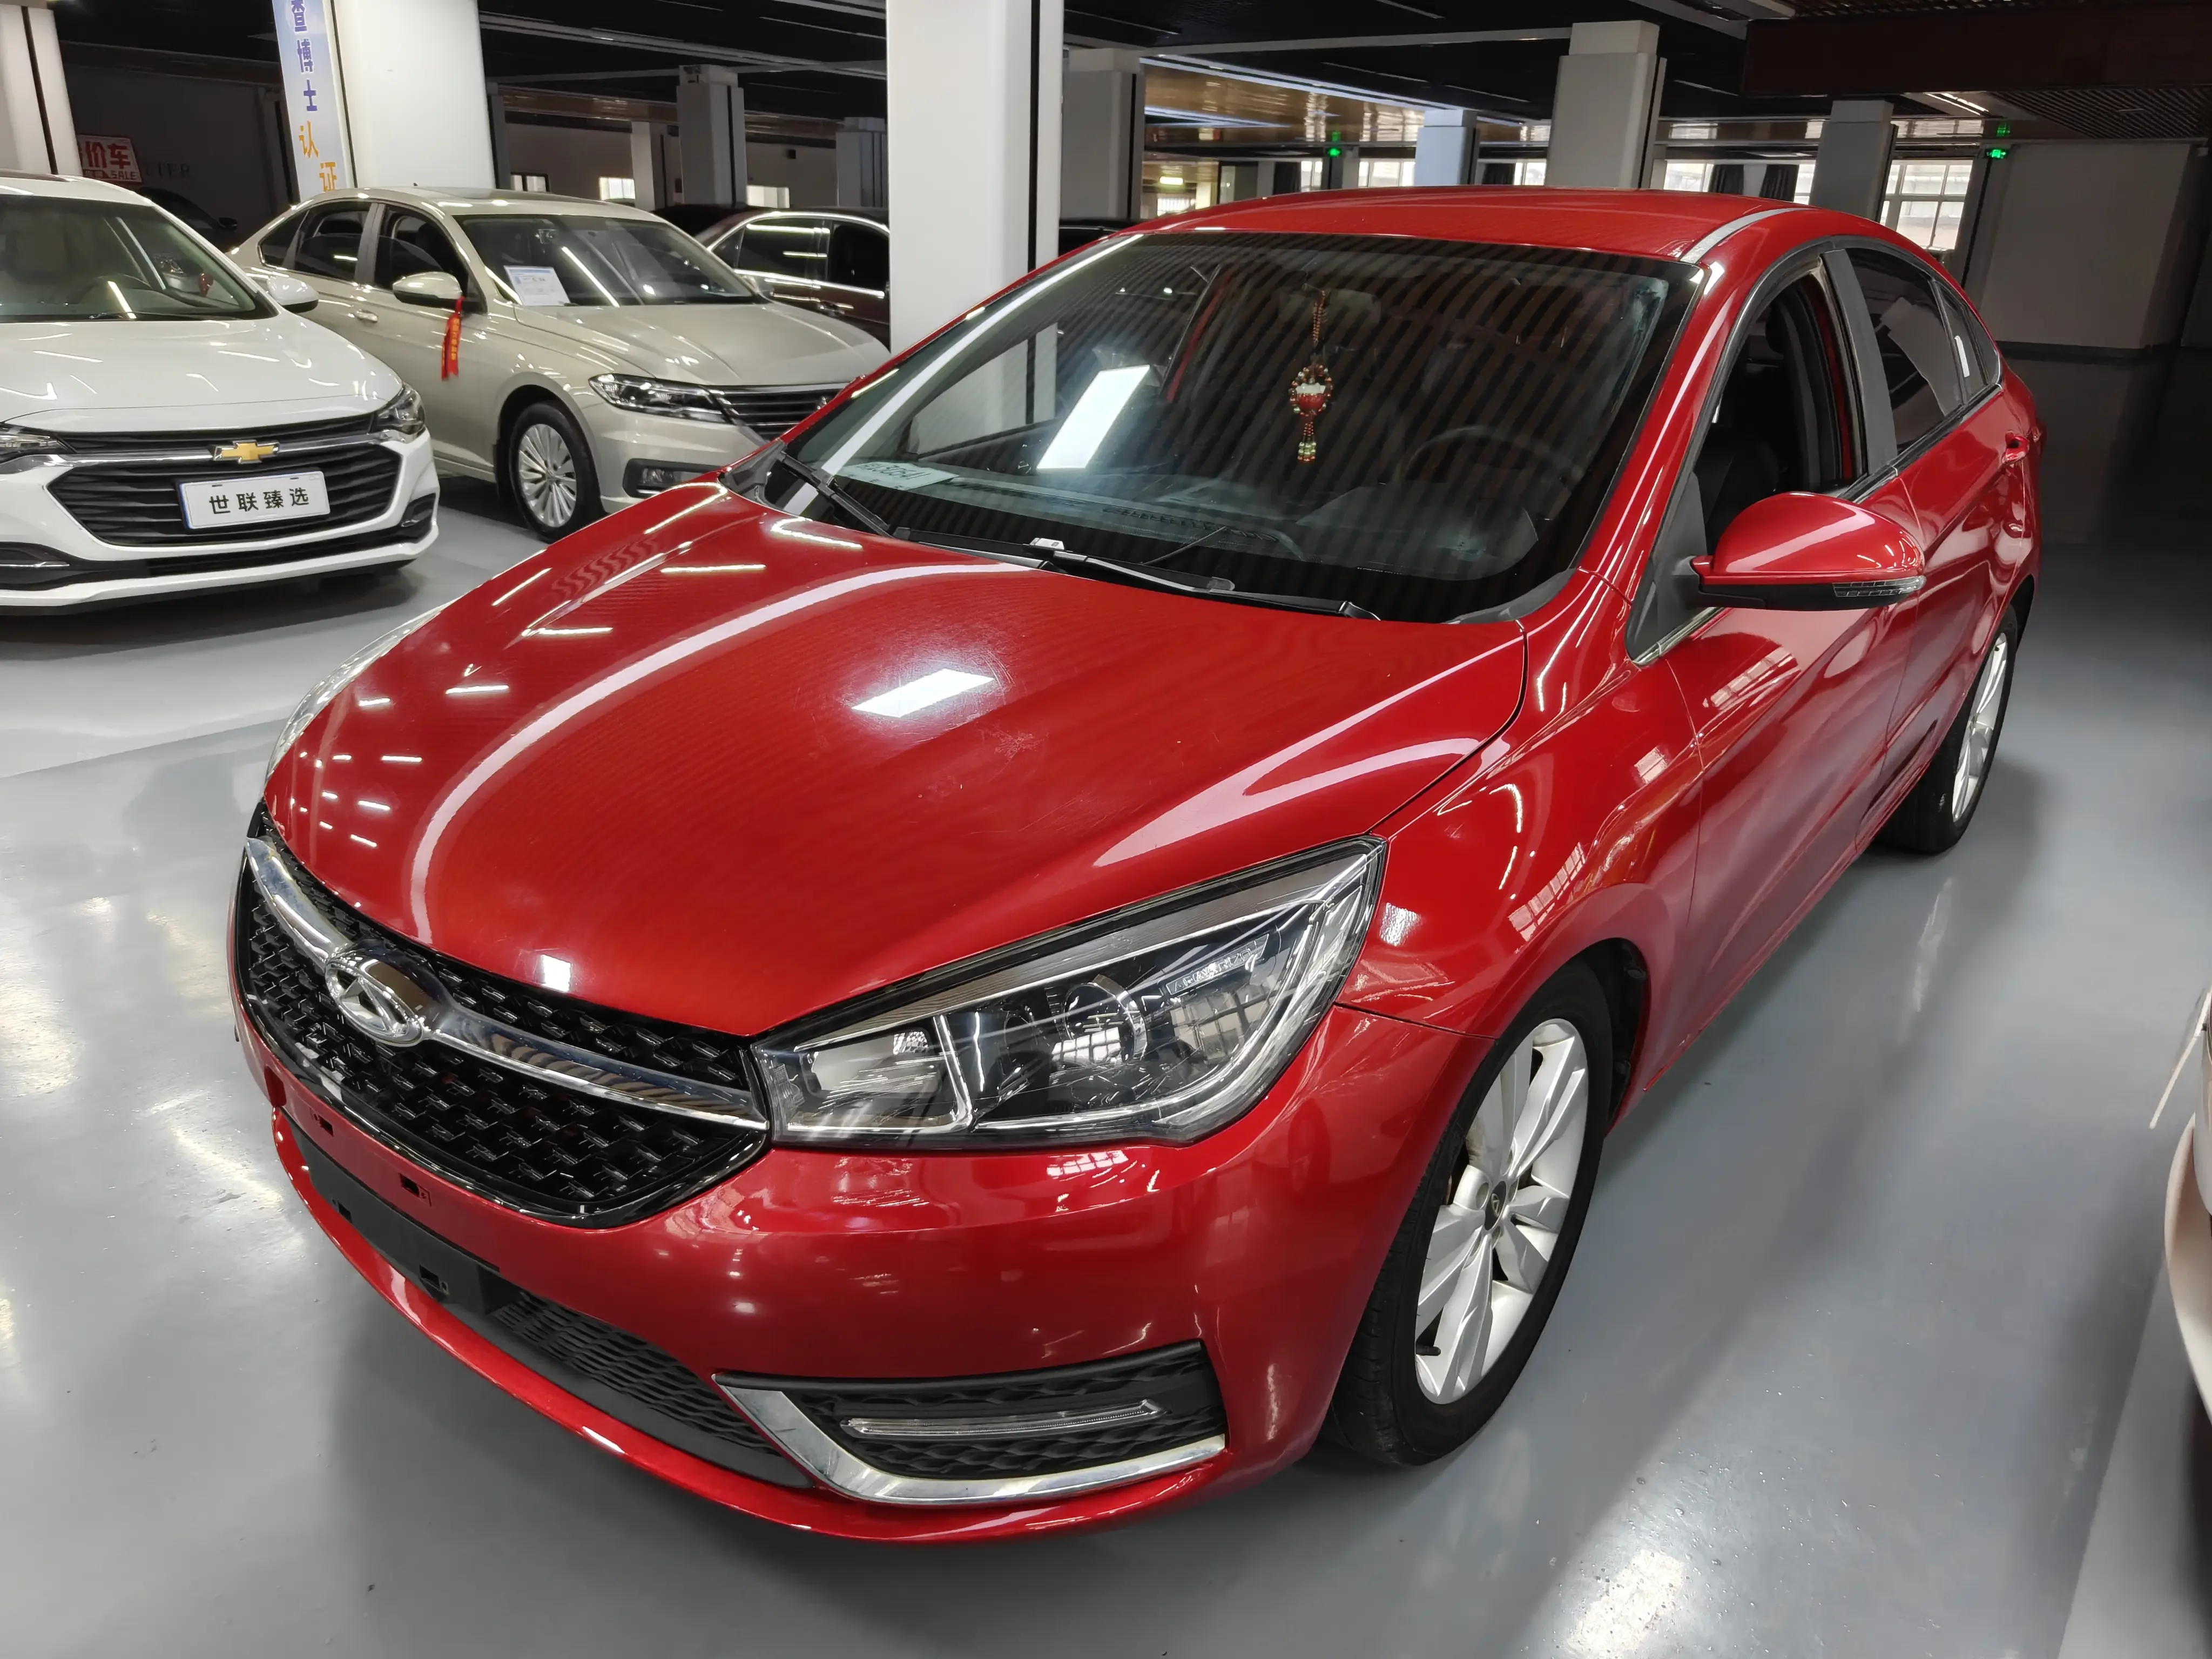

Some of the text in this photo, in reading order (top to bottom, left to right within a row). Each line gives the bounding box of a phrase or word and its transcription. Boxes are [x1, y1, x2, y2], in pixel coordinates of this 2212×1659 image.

[80, 141, 131, 170] 价车
[111, 170, 138, 180] SALE
[209, 487, 309, 514] 世联臻选
